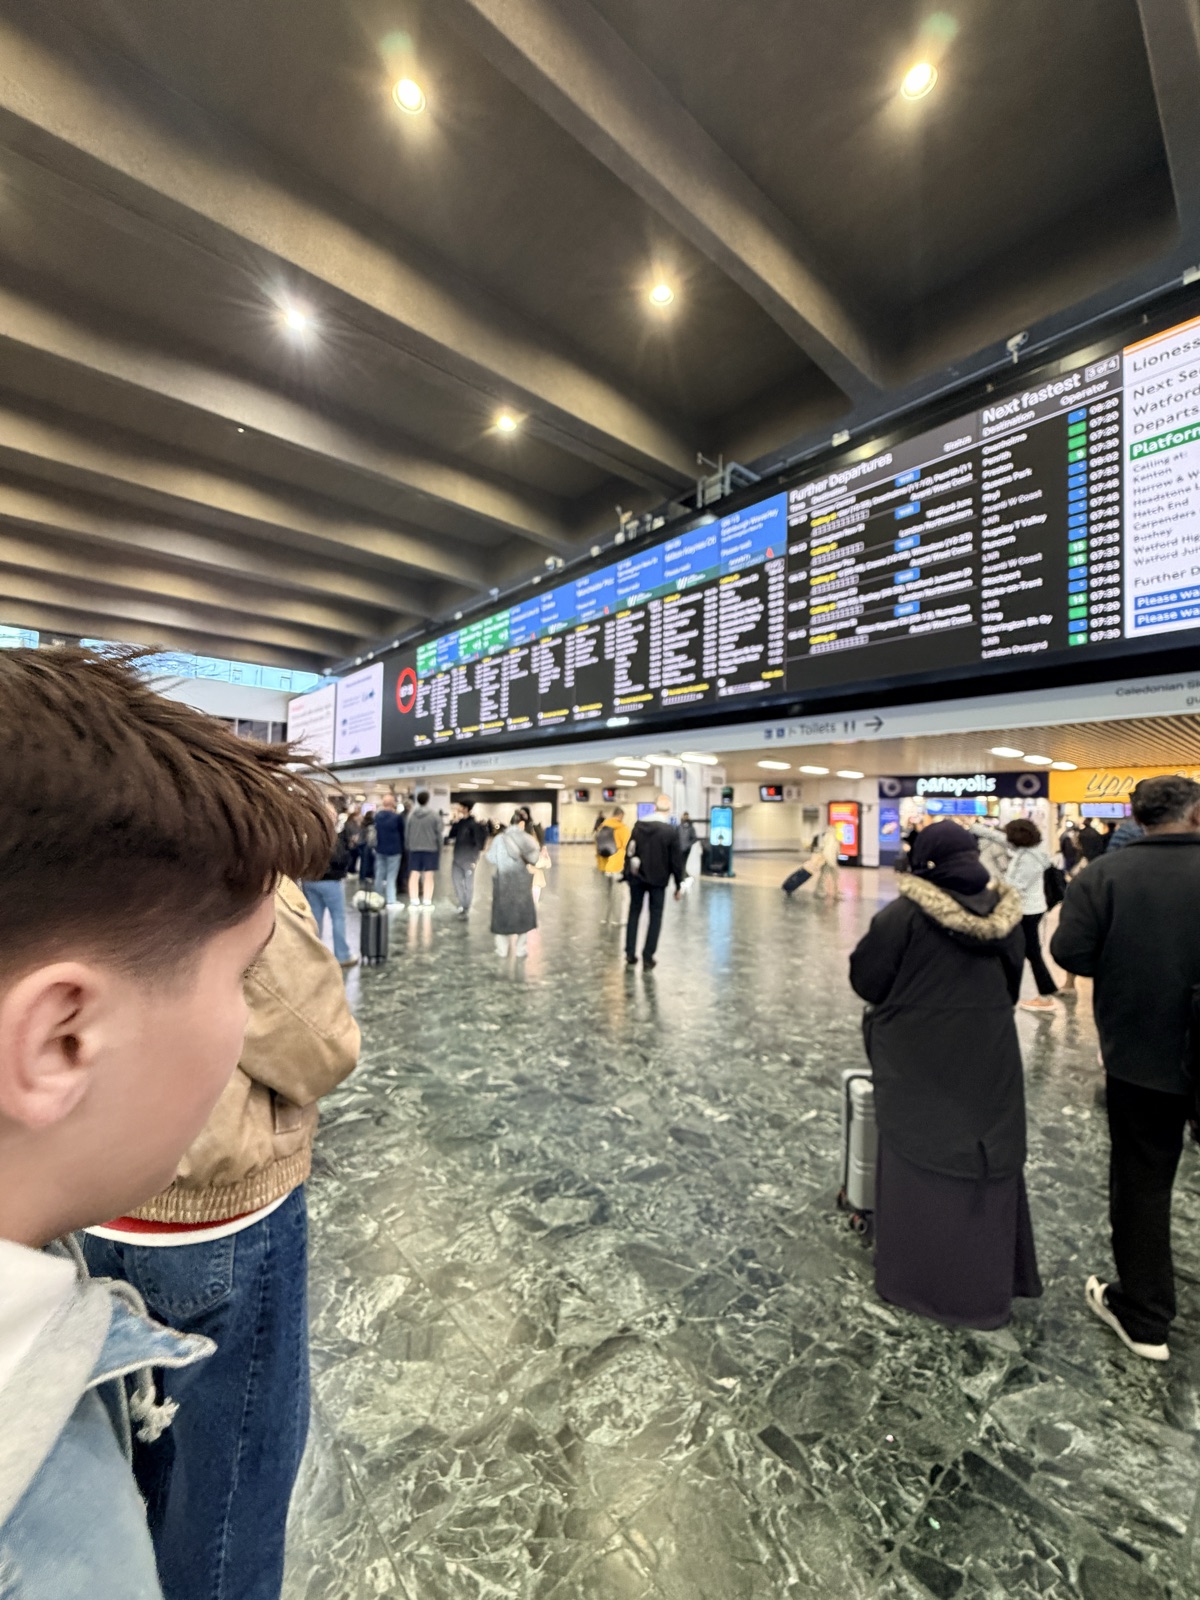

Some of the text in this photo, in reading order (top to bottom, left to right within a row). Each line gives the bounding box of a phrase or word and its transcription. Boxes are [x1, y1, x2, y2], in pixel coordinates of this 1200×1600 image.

[1133, 337, 1200, 372] Lioness
[983, 373, 1081, 424] Next fastest
[1060, 381, 1109, 405] Operator
[1133, 377, 1173, 400] Next
[1133, 386, 1200, 417] Watford
[1133, 405, 1199, 435] Departs
[790, 453, 893, 503] Further Departures
[1168, 498, 1189, 510] End
[1134, 569, 1187, 588] Further
[1137, 592, 1178, 607] Please
[1137, 610, 1178, 625] Please
[1115, 682, 1185, 697] Caledonian
[799, 722, 836, 736] Toilets
[916, 774, 997, 797] panopolis
